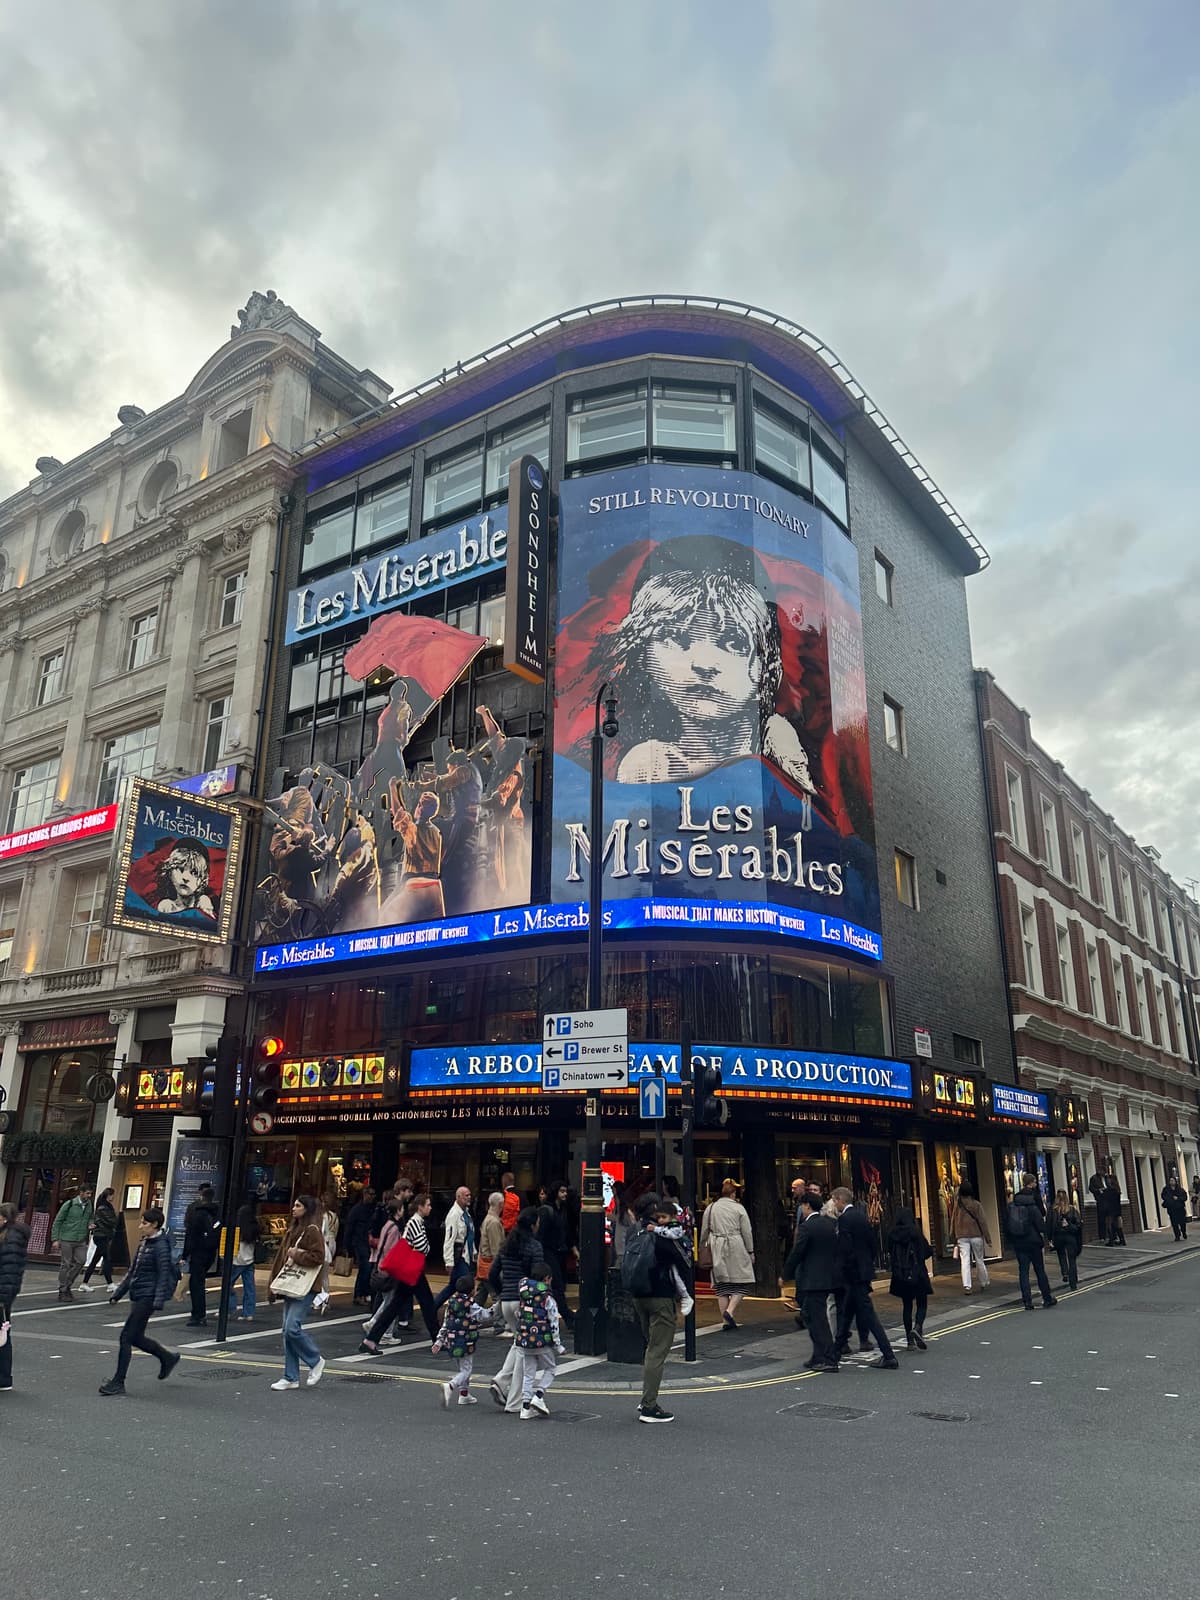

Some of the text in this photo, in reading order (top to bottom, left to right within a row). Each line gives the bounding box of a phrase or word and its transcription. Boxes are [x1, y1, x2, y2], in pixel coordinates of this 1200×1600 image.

[588, 487, 811, 539] STILL REVOLUTIONARY
[294, 515, 508, 633] Les Misérable
[522, 491, 541, 657] SONDHEIM
[519, 651, 542, 670] THEATRE
[174, 804, 196, 823] Les
[677, 786, 753, 833] Les
[11, 834, 28, 849] WITH
[50, 817, 83, 838] GLORIOUS
[143, 804, 224, 846] Misérables
[564, 818, 845, 896] Misérables
[260, 950, 279, 968] Les
[281, 941, 335, 964] Misérables
[354, 936, 379, 952] MUSICAL
[380, 933, 394, 949] THAT
[394, 930, 415, 947] MAKES
[441, 925, 469, 940] NEWSWEEK
[493, 914, 519, 936] Les
[652, 907, 690, 922] MUSICAL
[691, 907, 712, 922] THAT
[713, 908, 744, 923] MAKES
[779, 915, 806, 932] NEWSWEEK
[820, 918, 842, 941] Les
[843, 926, 879, 956] Misérables
[573, 1020, 594, 1029] Soho
[581, 1045, 610, 1055] Brewer
[612, 1044, 623, 1053] St
[562, 1071, 605, 1082] Chinatown
[731, 1056, 747, 1077] A
[339, 1112, 371, 1122] BOUBLIL
[372, 1112, 389, 1121] AND
[451, 1107, 471, 1118] LES
[476, 1104, 550, 1117] MISÉRABLES
[1001, 1100, 1020, 1113] PERFECT
[190, 1155, 201, 1164] Les
